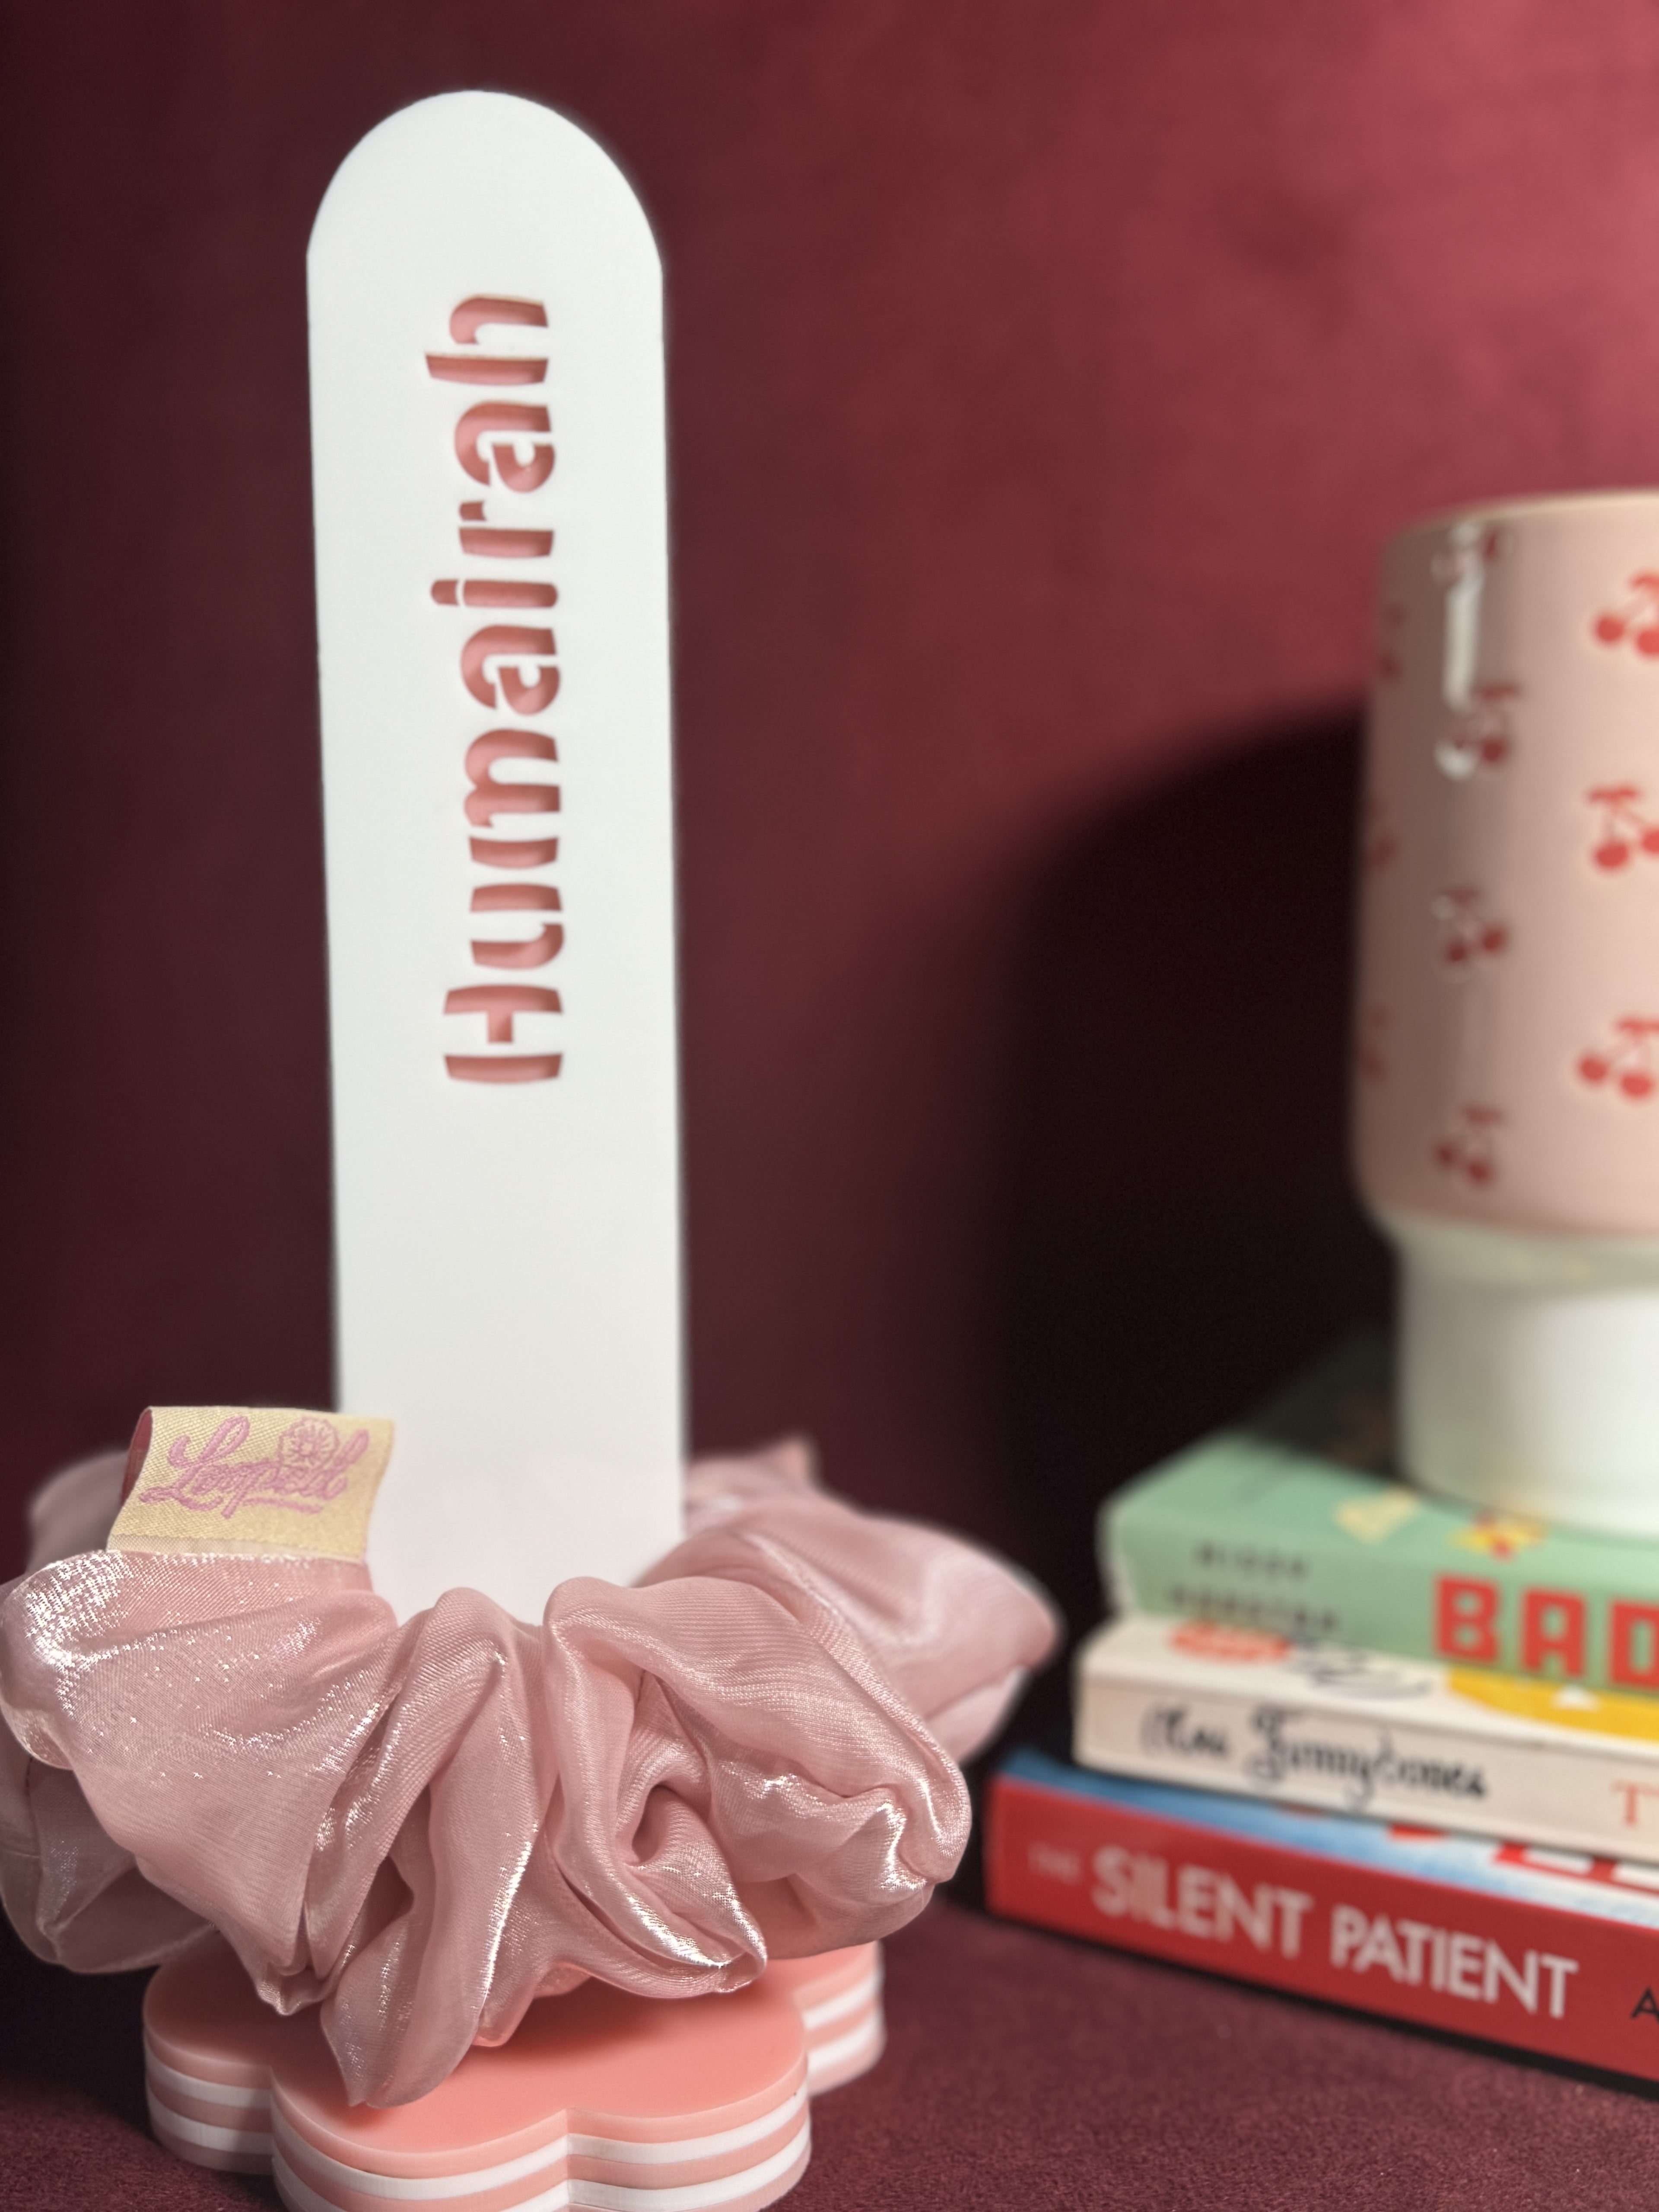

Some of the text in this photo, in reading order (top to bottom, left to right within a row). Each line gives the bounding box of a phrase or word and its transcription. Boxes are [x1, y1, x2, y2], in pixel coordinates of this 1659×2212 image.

[425, 294, 564, 1084] Humairah
[1435, 1573, 1659, 1689] BAD
[1091, 1844, 1314, 1958] SILENT
[1330, 1904, 1579, 2019] PATIENT
